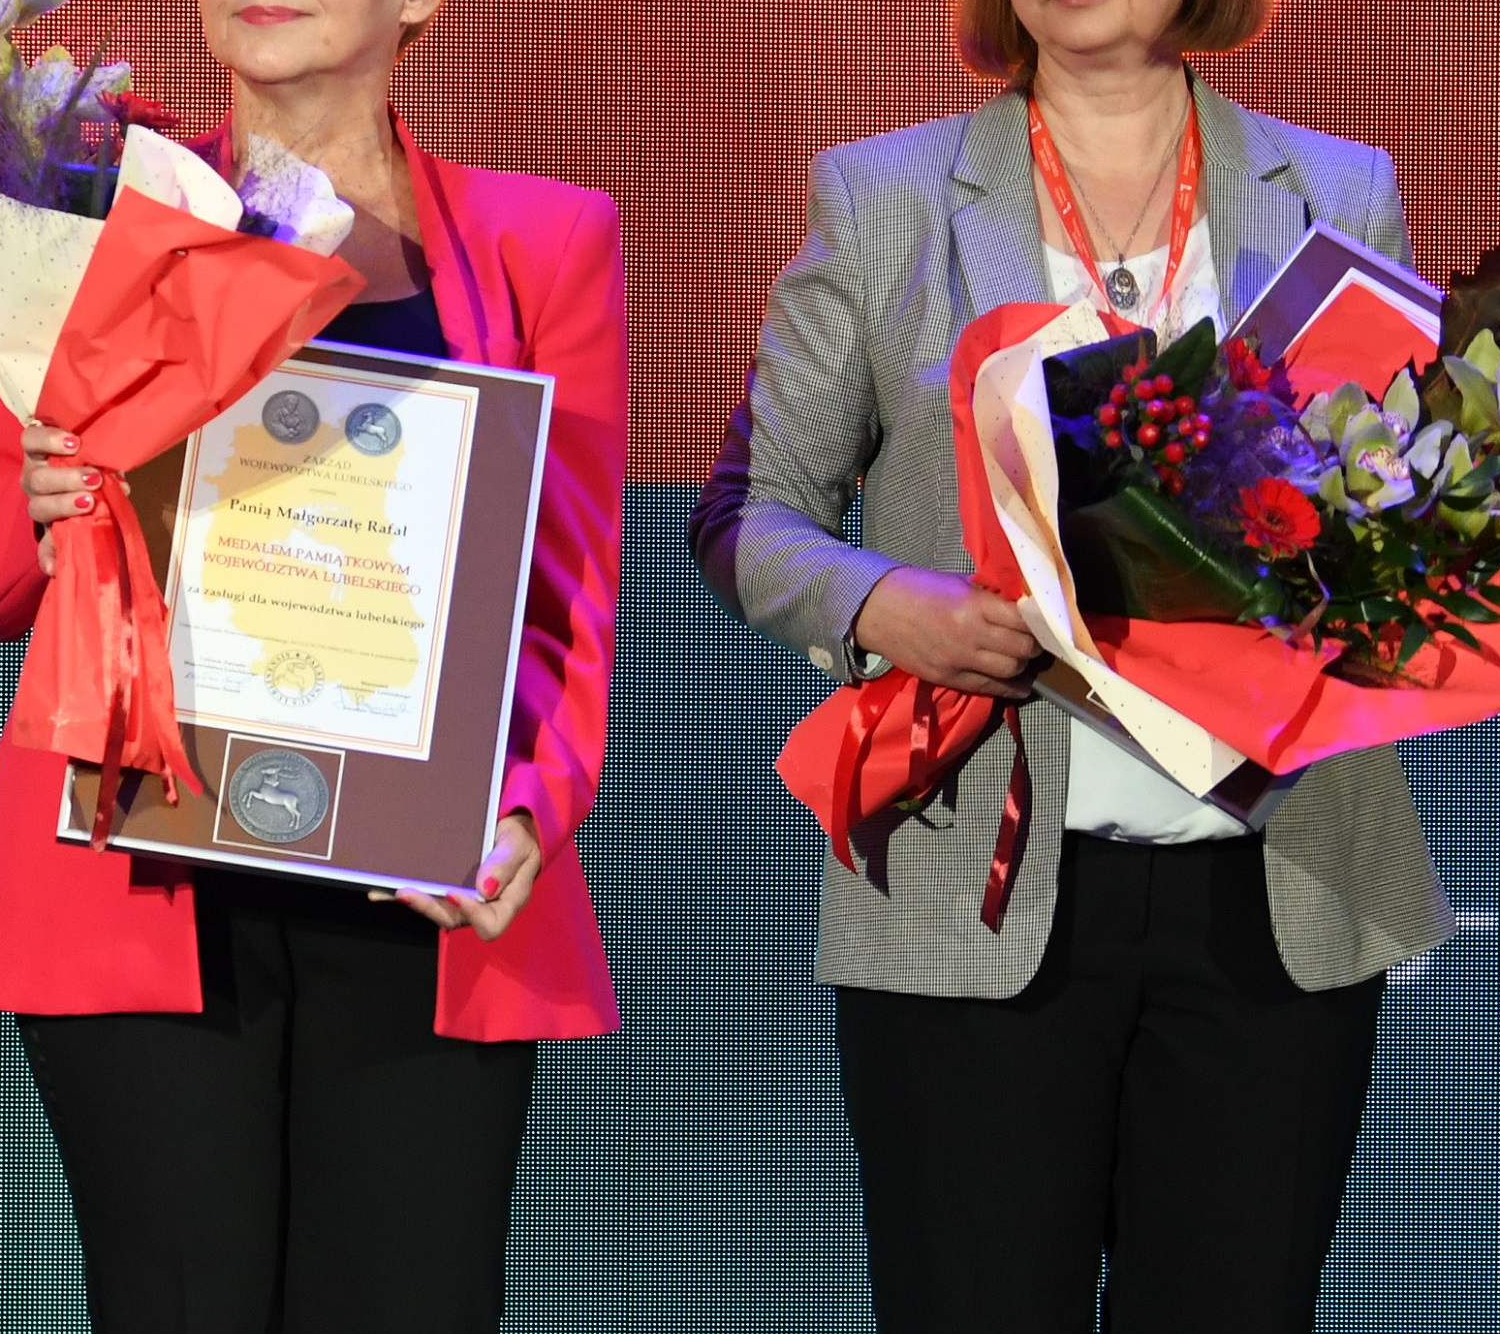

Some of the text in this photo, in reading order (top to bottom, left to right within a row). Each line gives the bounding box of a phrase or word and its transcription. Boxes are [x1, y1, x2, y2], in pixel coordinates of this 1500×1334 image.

[334, 472, 413, 492] LUBELSKIEGO
[229, 498, 272, 519] Panią
[276, 505, 362, 531] Małgorzatę
[202, 551, 422, 596] WOJEWÓDZTWA LUBELSKIEGO
[217, 535, 411, 576] MEDALEM PAMIĄTKOWYM
[187, 585, 200, 594] za
[248, 593, 267, 605] dla
[355, 610, 425, 630] lubelskiego
